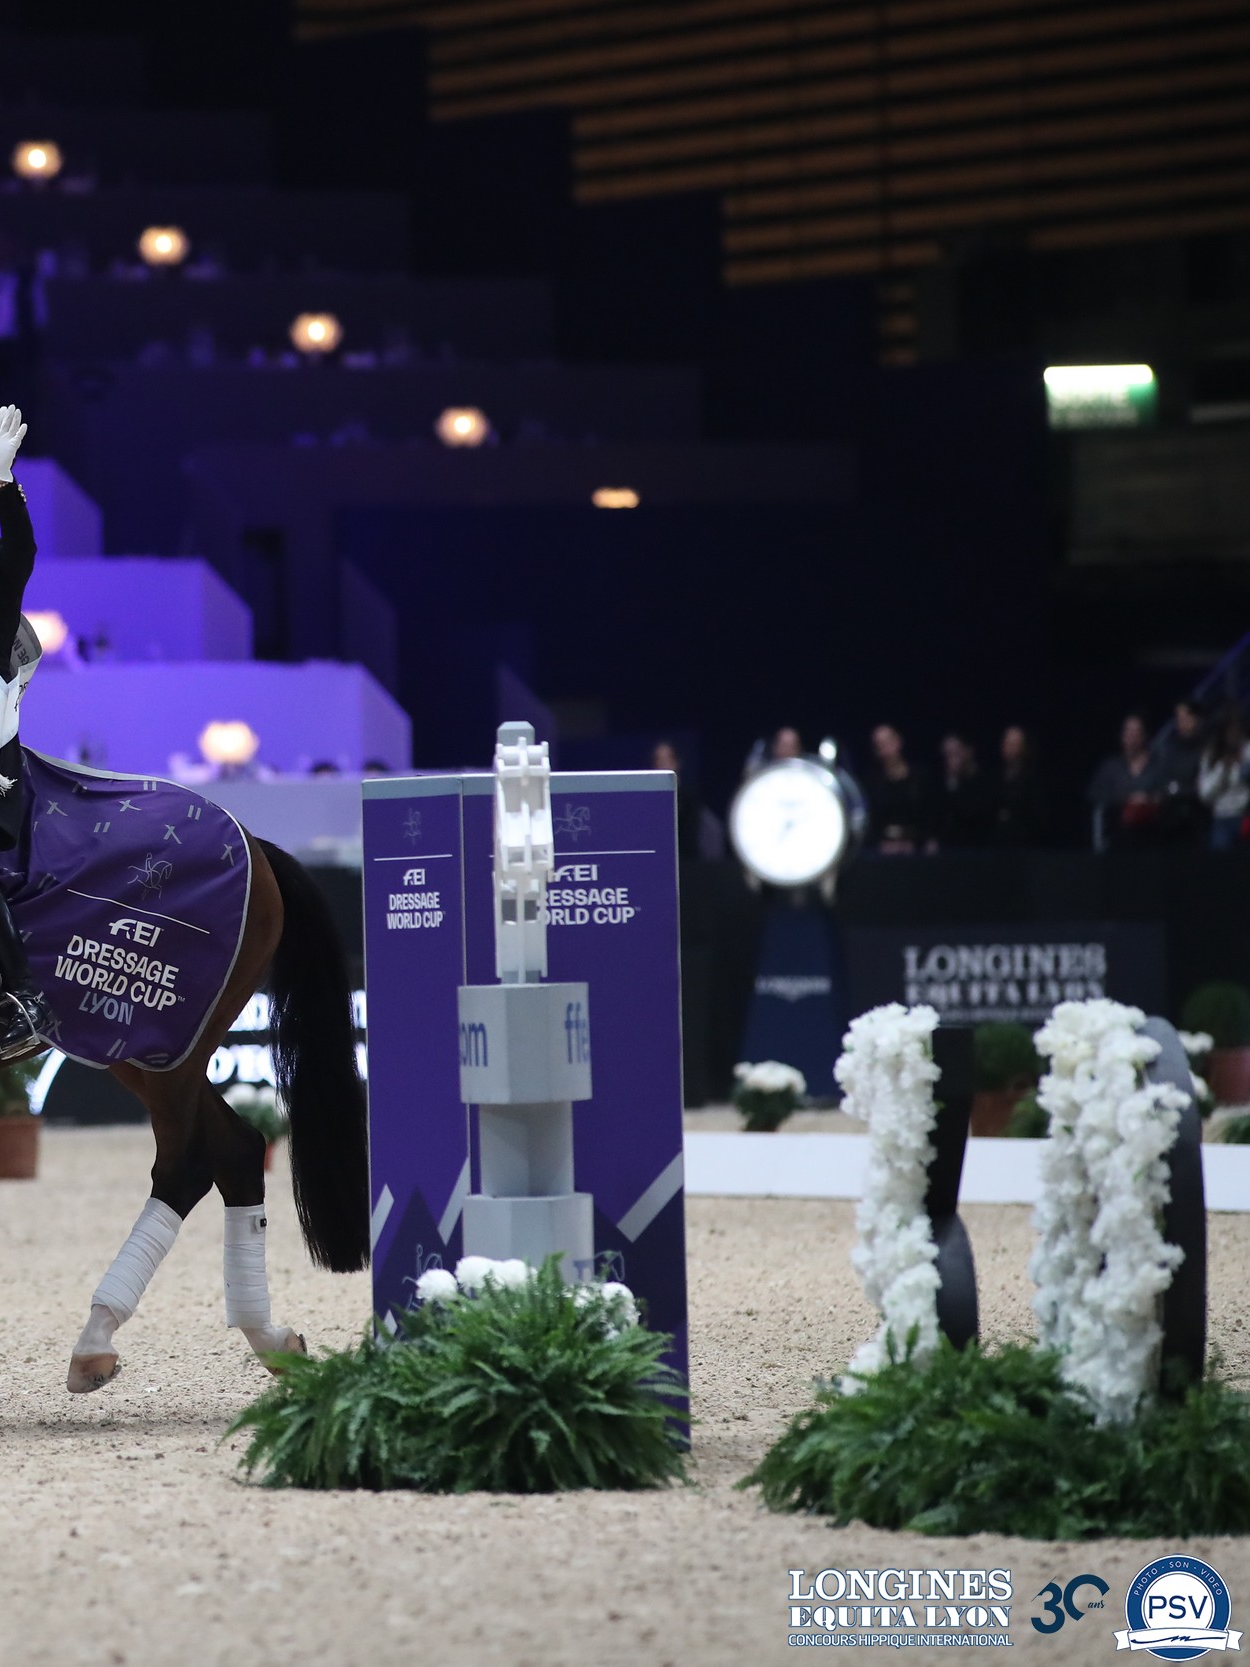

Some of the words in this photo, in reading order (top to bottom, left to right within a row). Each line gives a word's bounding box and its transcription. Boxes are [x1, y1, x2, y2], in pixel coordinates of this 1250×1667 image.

[403, 868, 426, 886] FEI
[553, 864, 598, 882] FEI
[389, 891, 441, 911] DRESSAGE
[386, 911, 422, 930] WORLD
[422, 910, 444, 928] CUP
[593, 906, 635, 924] CUP
[108, 918, 162, 947] FEI
[66, 934, 180, 989] DRESSAGE
[54, 955, 128, 996] WORLD
[78, 990, 134, 1026] LYON
